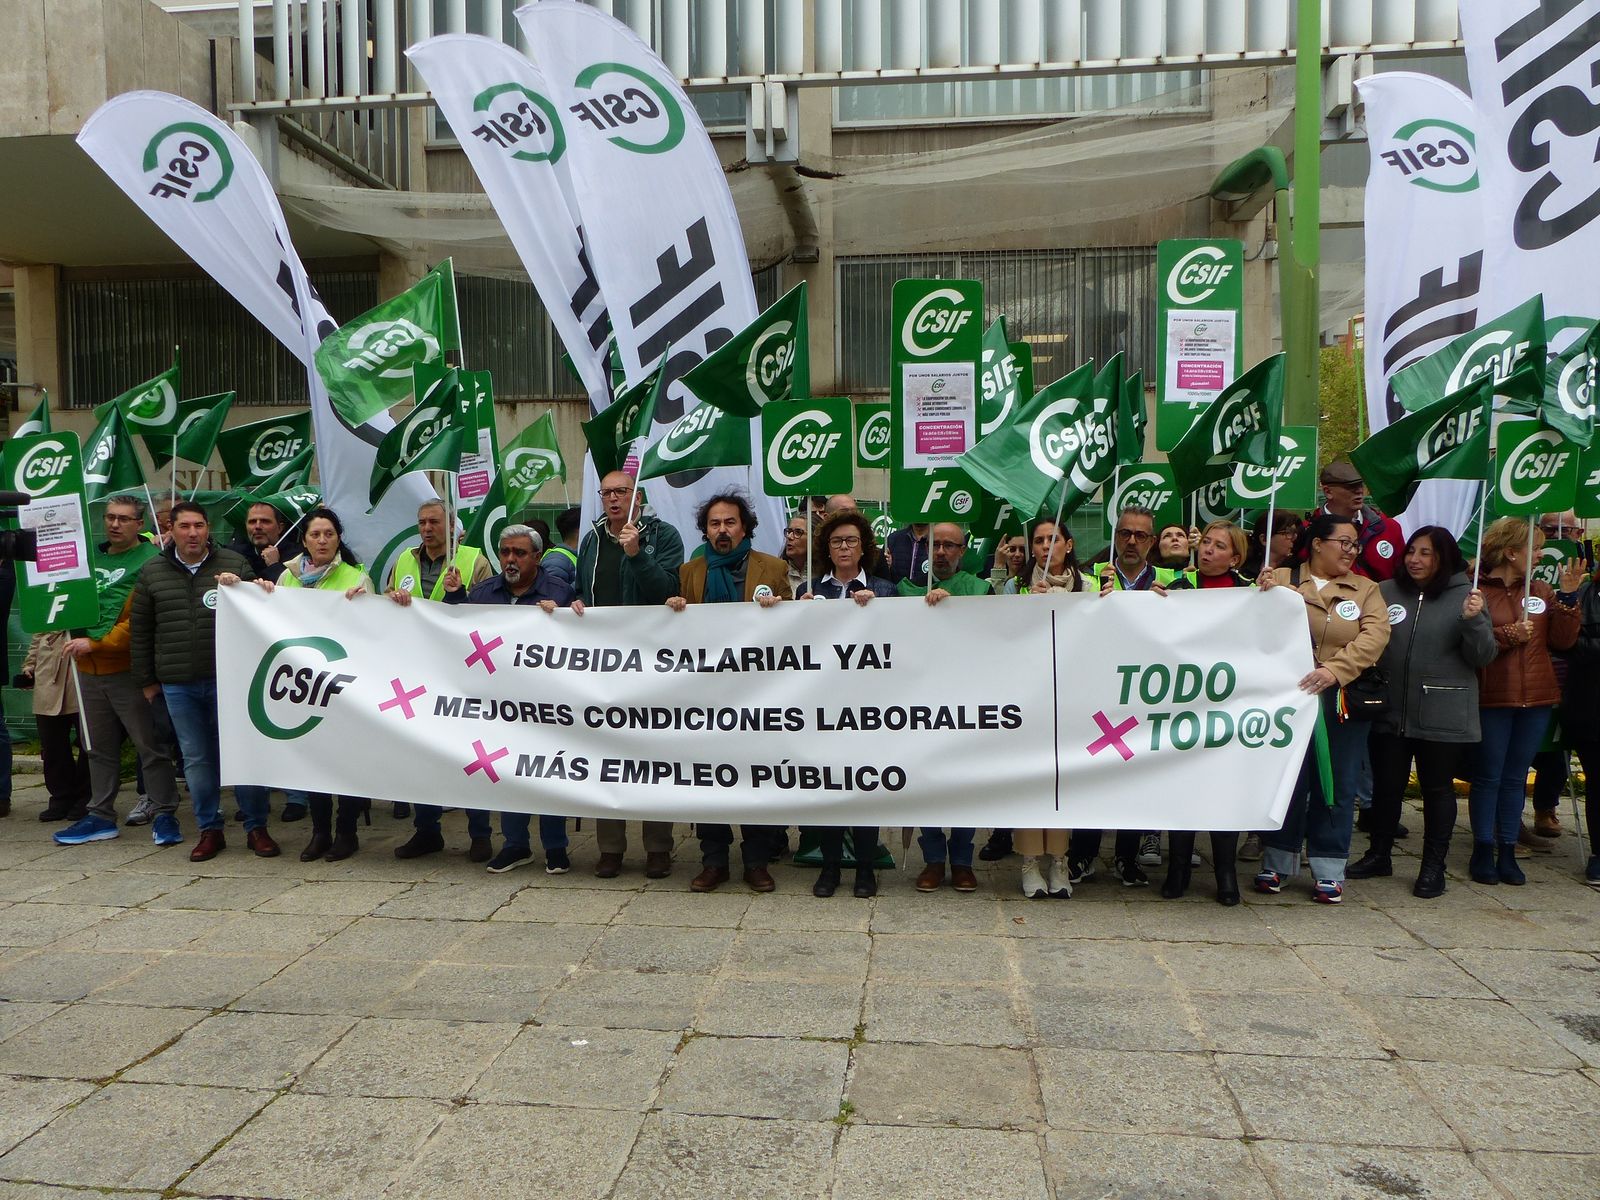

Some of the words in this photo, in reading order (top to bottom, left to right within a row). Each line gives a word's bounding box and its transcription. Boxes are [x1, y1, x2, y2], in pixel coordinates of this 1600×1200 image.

[1180, 263, 1233, 286] CSIF
[916, 309, 972, 333] CSIF
[982, 354, 1016, 400] SIF
[258, 438, 303, 461] CSIF
[781, 432, 842, 461] CSIF
[1045, 411, 1096, 460] CSIF
[26, 455, 73, 479] CSIF
[1514, 452, 1570, 480] CSIF
[514, 643, 643, 673] ¡SUBIDA
[654, 644, 822, 673] SALARIAL
[832, 643, 892, 670] YA!
[269, 663, 358, 708] CSIF
[1117, 661, 1237, 706] TODO
[433, 695, 575, 727] MEJORES
[583, 705, 805, 732] CONDICIONES
[816, 704, 1023, 731] LABORALES
[1147, 706, 1297, 752] TOD@S
[515, 750, 589, 781] MÁS
[599, 758, 739, 788] EMPLEO
[750, 758, 907, 792] PÚBLICO
